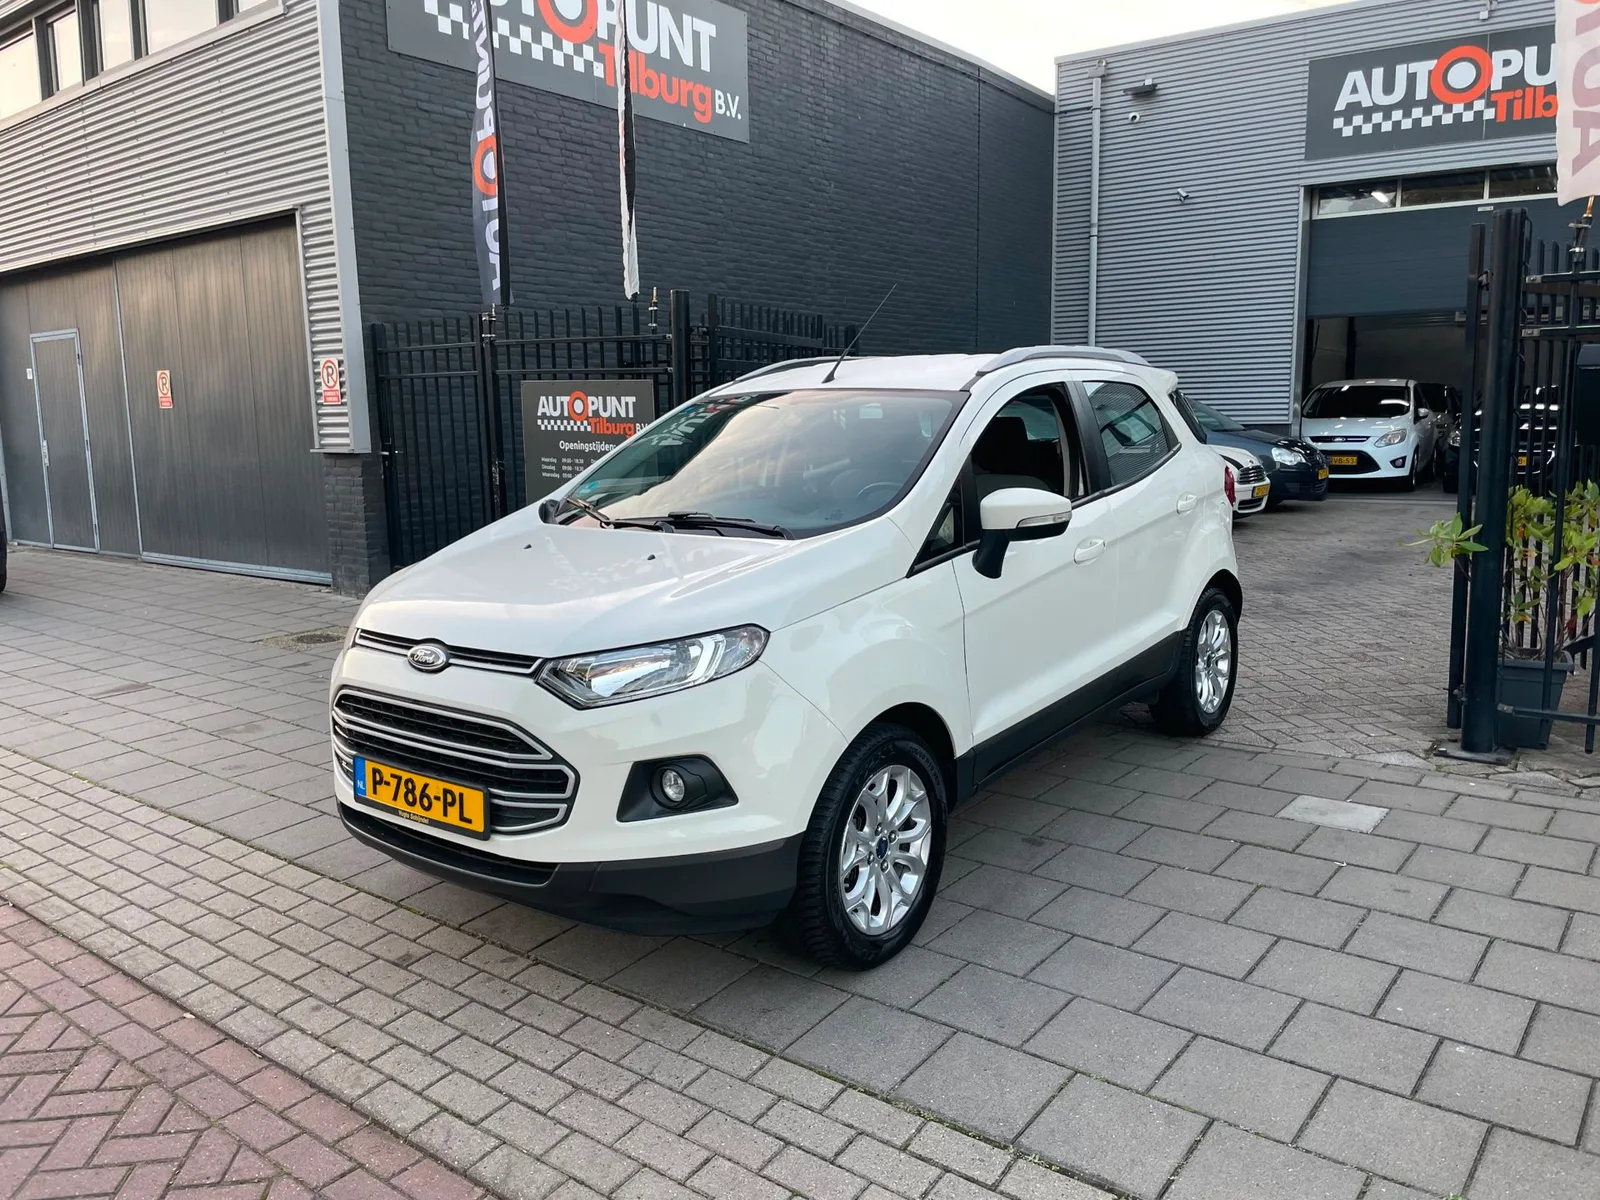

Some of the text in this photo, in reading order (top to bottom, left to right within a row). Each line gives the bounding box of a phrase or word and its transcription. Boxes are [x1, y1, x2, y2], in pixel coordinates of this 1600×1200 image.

[599, 42, 742, 123] Tlburg B.V.
[1334, 43, 1557, 112] AUTOPU
[1491, 86, 1559, 122] Tilb
[537, 391, 636, 421] AUTOPUNT
[589, 418, 635, 439] Tilburg
[371, 766, 473, 824] P-786-PL
